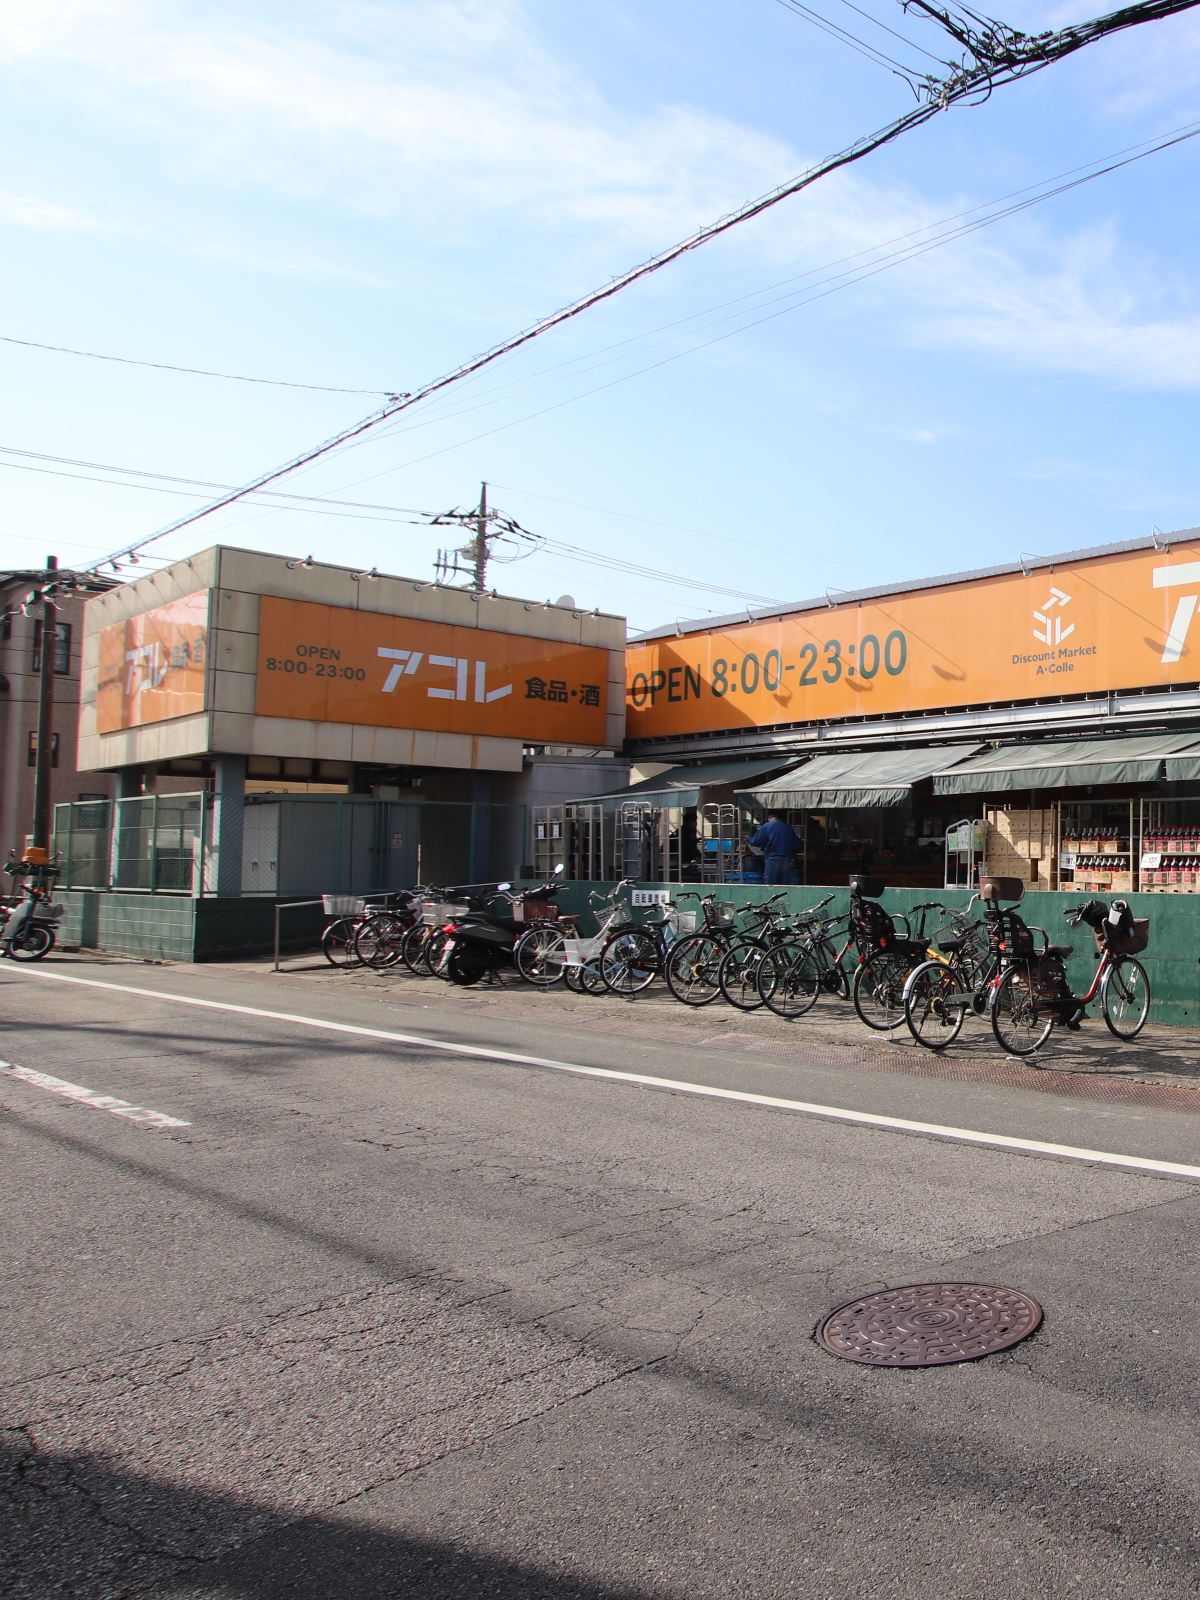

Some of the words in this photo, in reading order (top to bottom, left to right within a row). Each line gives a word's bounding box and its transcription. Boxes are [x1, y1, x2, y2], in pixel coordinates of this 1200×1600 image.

[296, 644, 341, 661] OPEN
[1012, 651, 1055, 664] Discount
[1058, 646, 1097, 659] Market
[266, 657, 366, 681] 8:00-23:00
[377, 646, 513, 704] アコレ
[631, 664, 700, 706] OPEN
[711, 630, 907, 697] 8:00-23:00
[524, 676, 600, 707] 食品・酒
